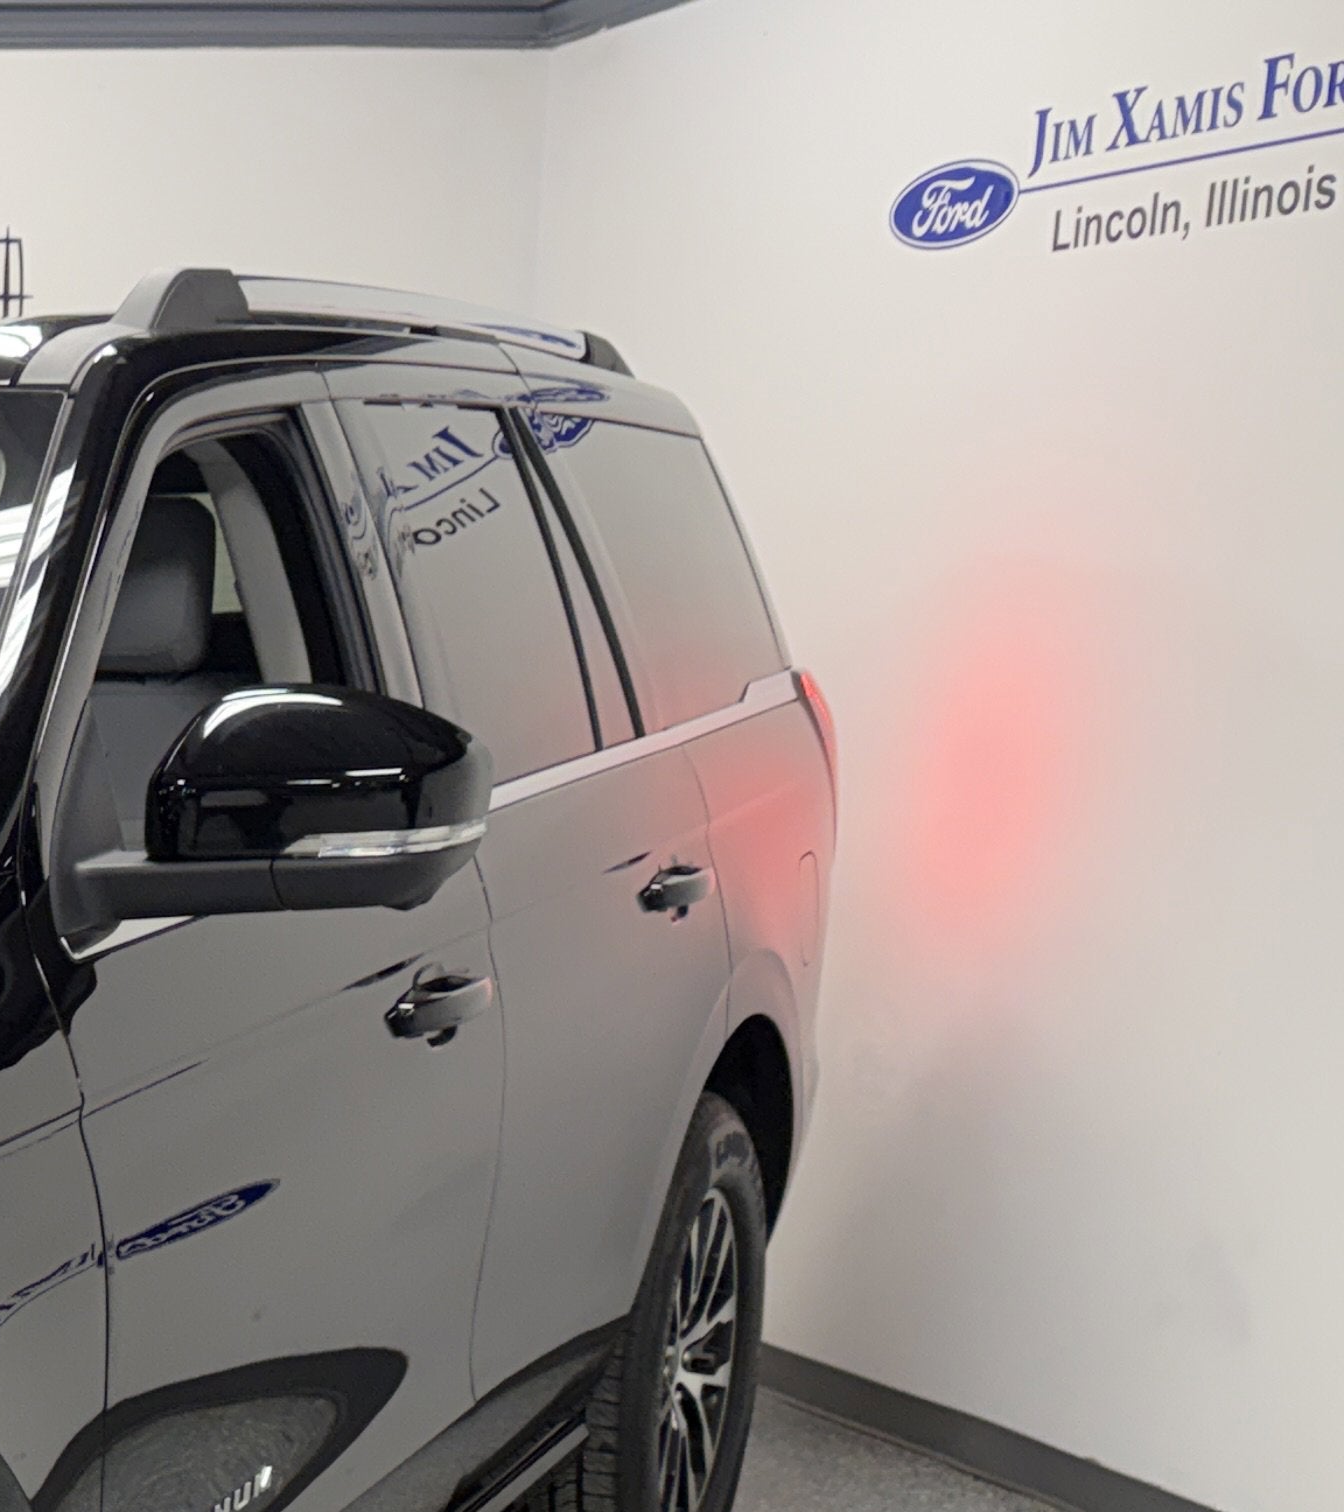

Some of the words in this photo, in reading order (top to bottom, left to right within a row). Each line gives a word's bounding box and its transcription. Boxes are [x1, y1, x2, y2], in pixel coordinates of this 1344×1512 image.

[1028, 107, 1098, 178] JIM
[1105, 82, 1246, 151] XAMIS
[1256, 53, 1344, 120] FOR
[1051, 192, 1191, 252] Lincoln,
[1204, 165, 1337, 227] Illinois
